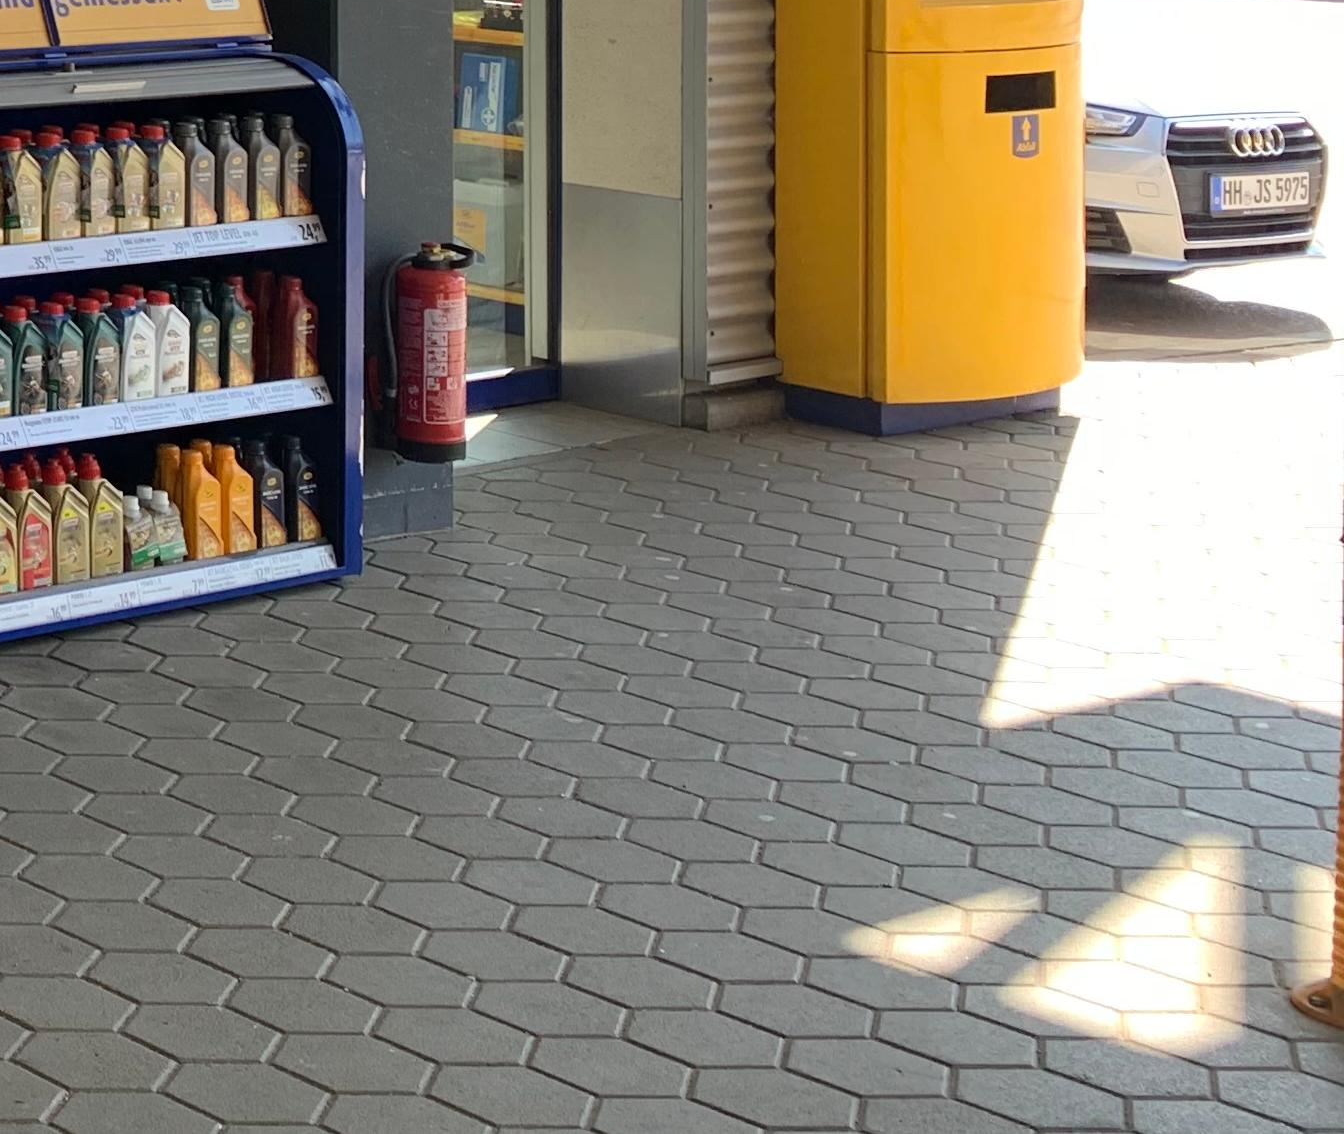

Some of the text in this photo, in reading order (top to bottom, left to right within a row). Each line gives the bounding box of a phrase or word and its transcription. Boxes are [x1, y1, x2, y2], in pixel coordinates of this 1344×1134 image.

[1223, 175, 1308, 205] HH JS 5975
